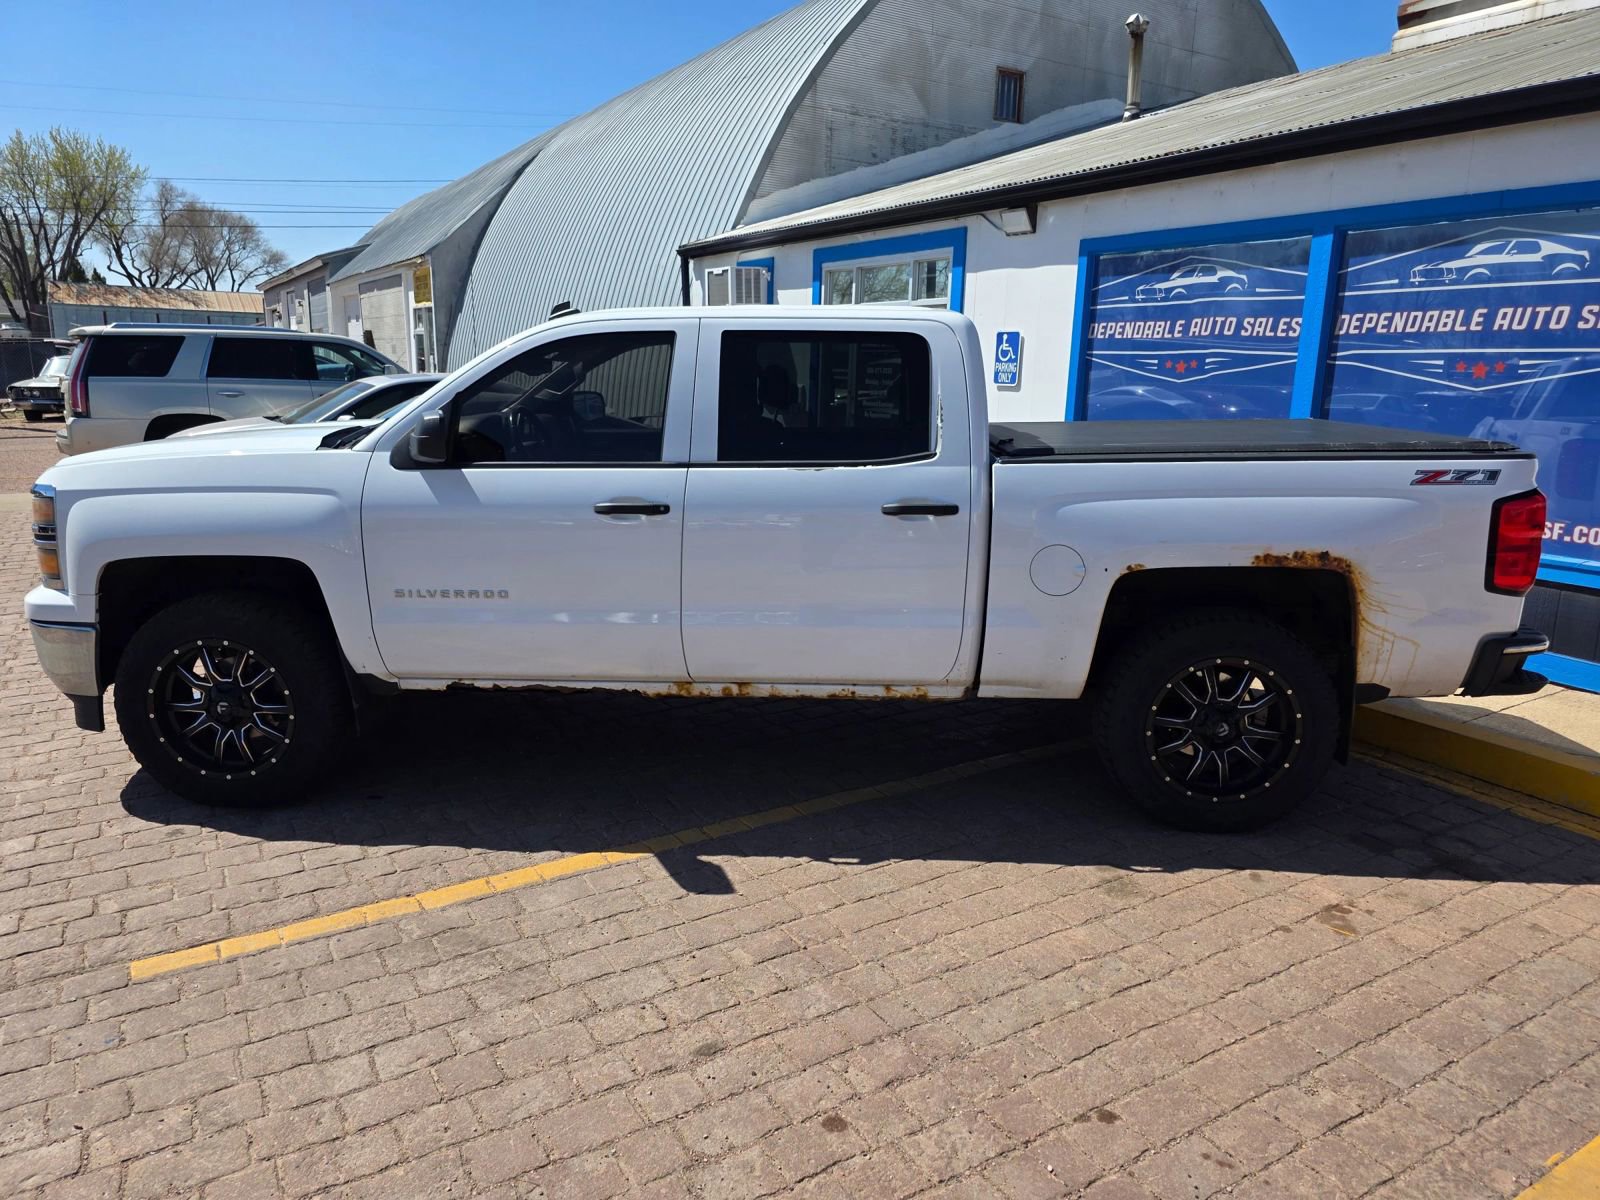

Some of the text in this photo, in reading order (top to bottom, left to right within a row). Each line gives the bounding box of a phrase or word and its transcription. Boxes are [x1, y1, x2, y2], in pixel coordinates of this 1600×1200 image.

[1334, 304, 1600, 335] DEPENDABLE AUTO S
[1088, 317, 1302, 339] DEPENDABLE AUTO SALES
[995, 362, 1017, 373] PARKING
[997, 372, 1013, 383] ONLY
[1410, 469, 1502, 486] Z71
[393, 588, 509, 599] SILVERADO
